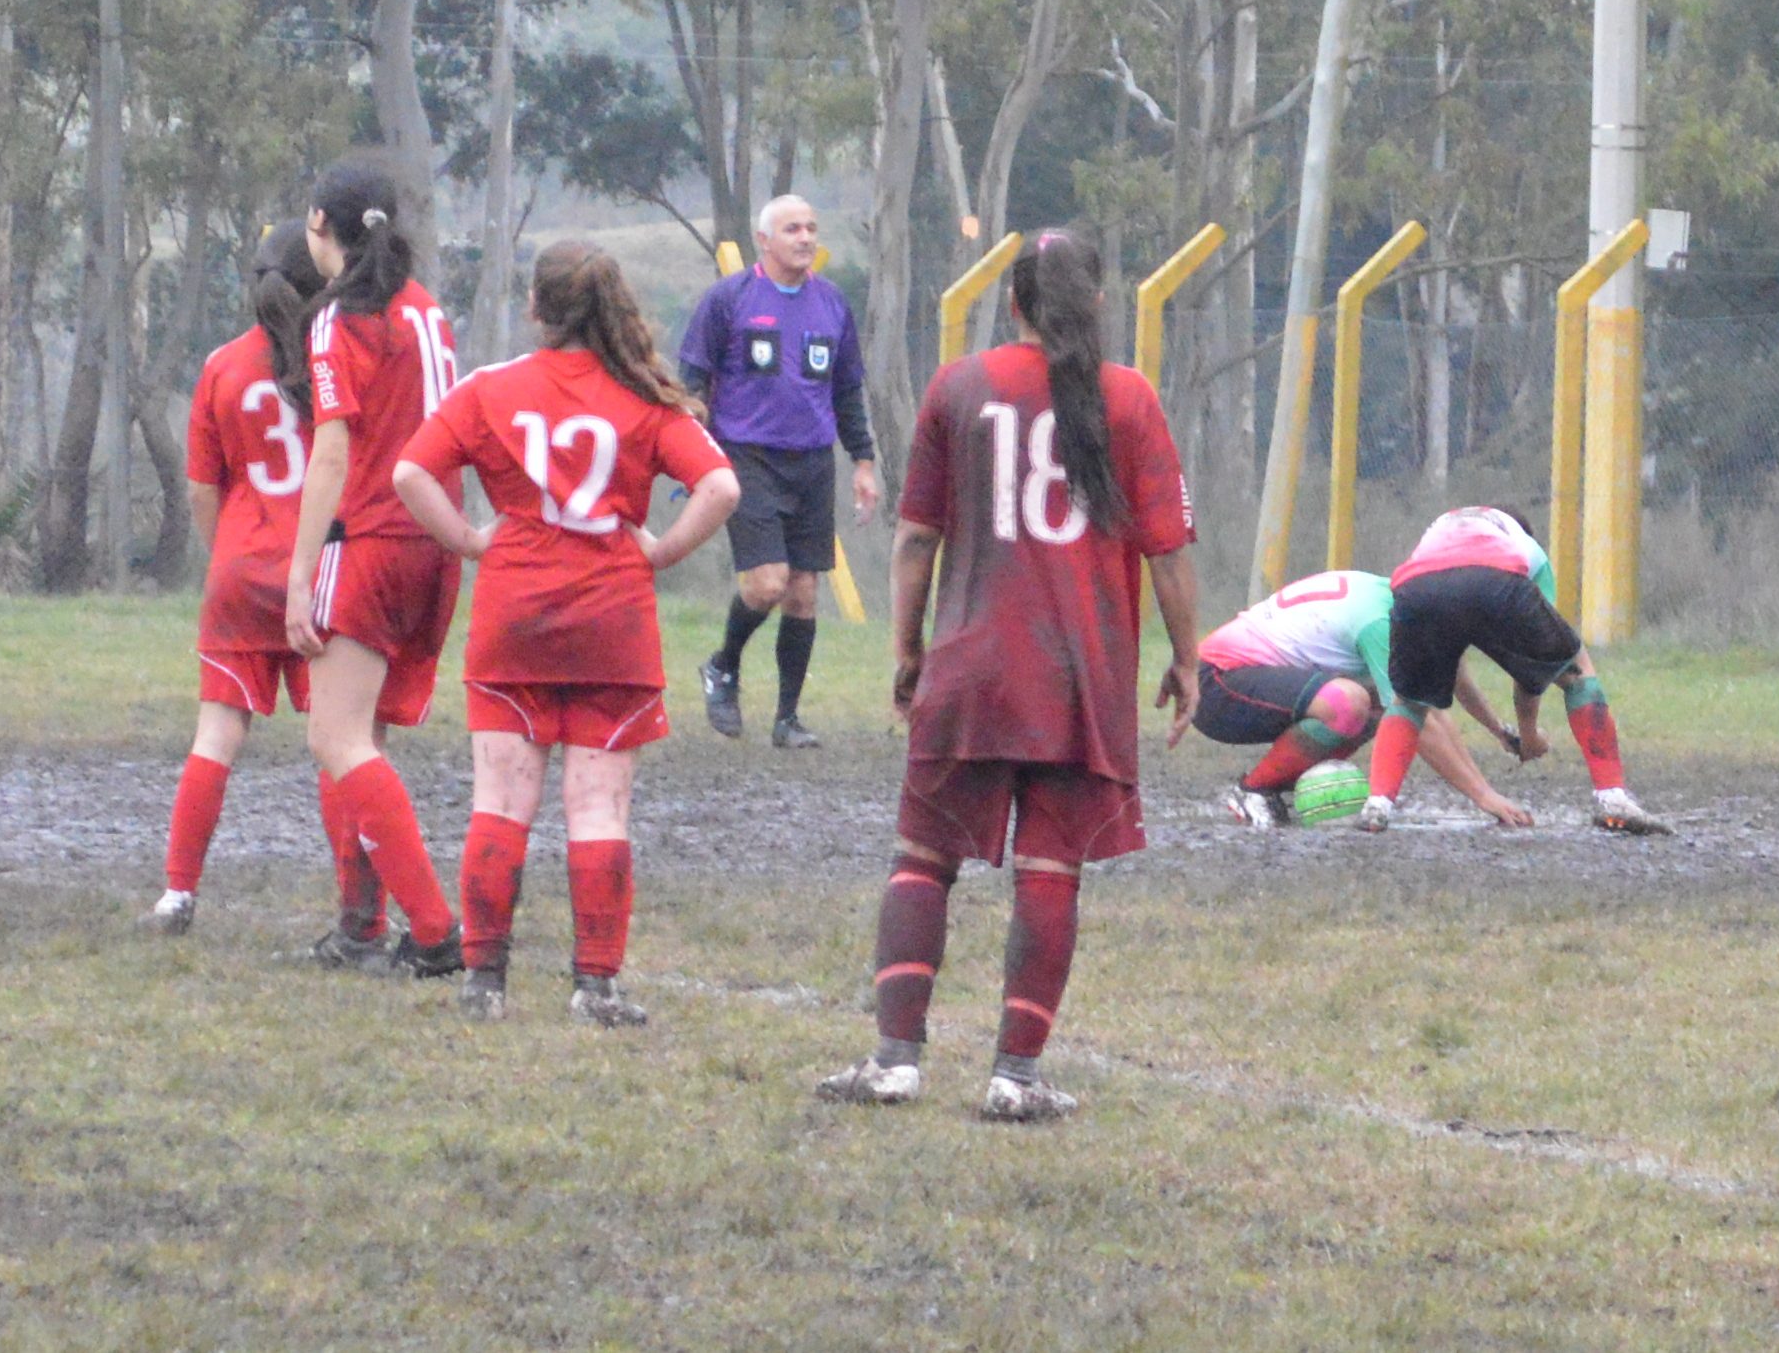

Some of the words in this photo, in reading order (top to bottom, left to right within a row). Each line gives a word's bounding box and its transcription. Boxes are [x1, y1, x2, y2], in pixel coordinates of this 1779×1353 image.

[241, 379, 306, 495] 3
[313, 361, 340, 410] antel
[511, 410, 619, 534] 12
[979, 401, 1090, 544] 18
